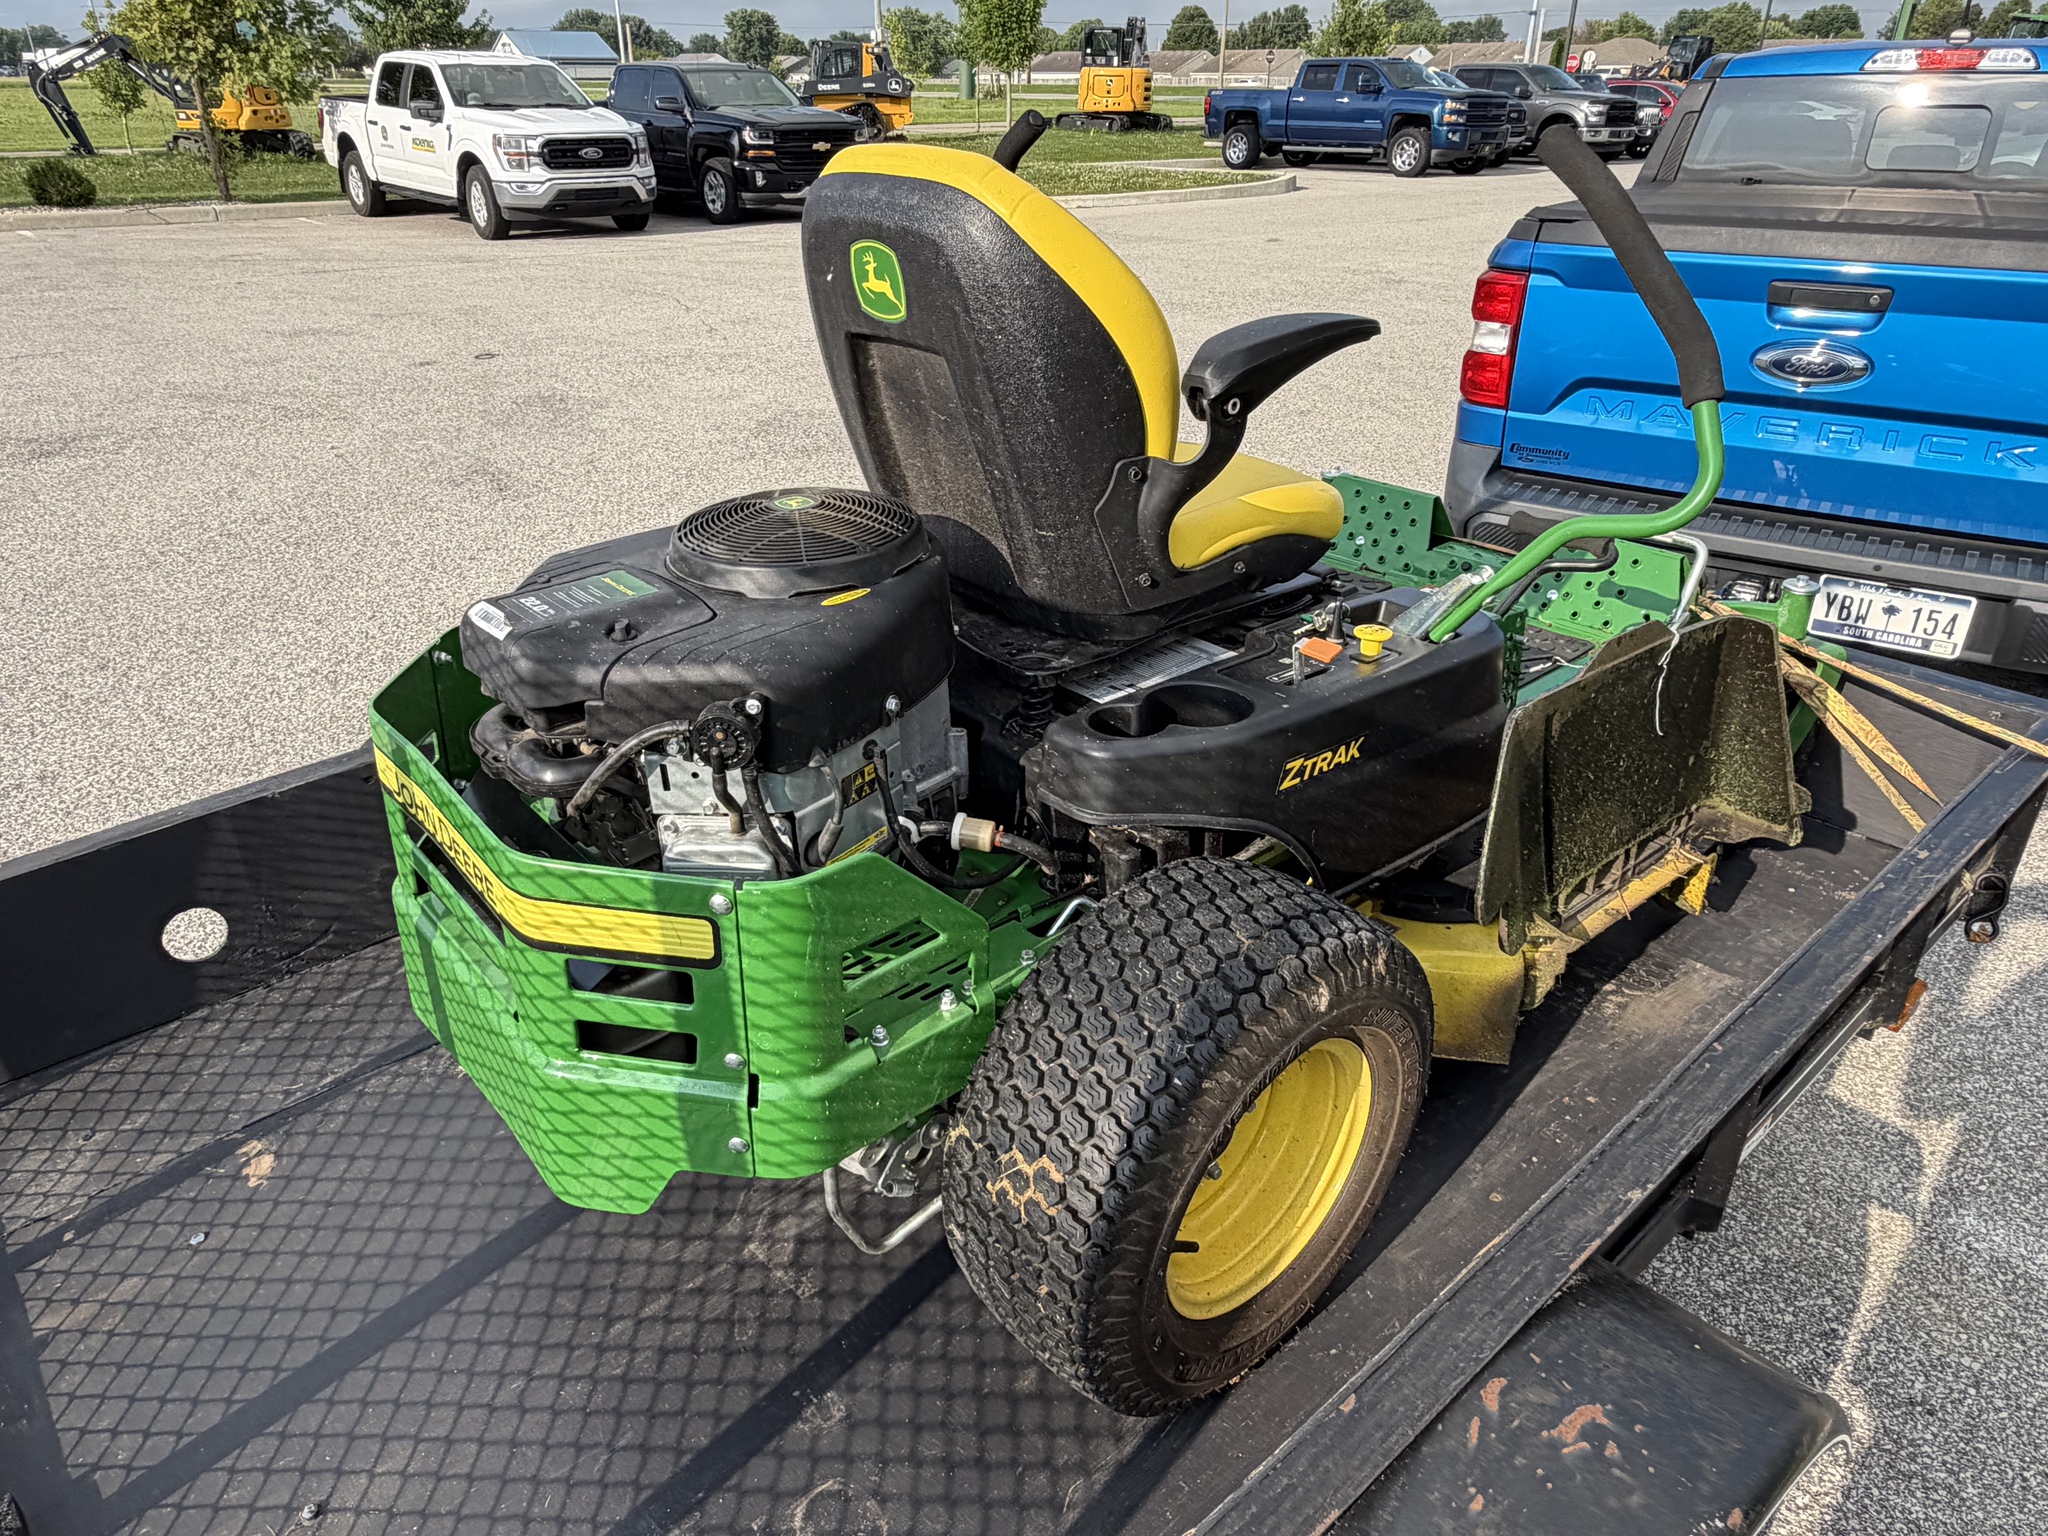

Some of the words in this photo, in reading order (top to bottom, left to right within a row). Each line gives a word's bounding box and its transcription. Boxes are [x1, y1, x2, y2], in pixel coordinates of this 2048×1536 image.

[1784, 354, 1834, 376] Ford
[1509, 442, 1570, 460] Community
[1824, 591, 1873, 626] YBW
[1911, 607, 1960, 641] 154
[1843, 625, 1873, 639] SOUTH
[1875, 630, 1923, 648] CAROLINA
[1279, 736, 1365, 791] ZTRAK
[394, 771, 438, 835] JOHN
[438, 814, 498, 907] DEERE
